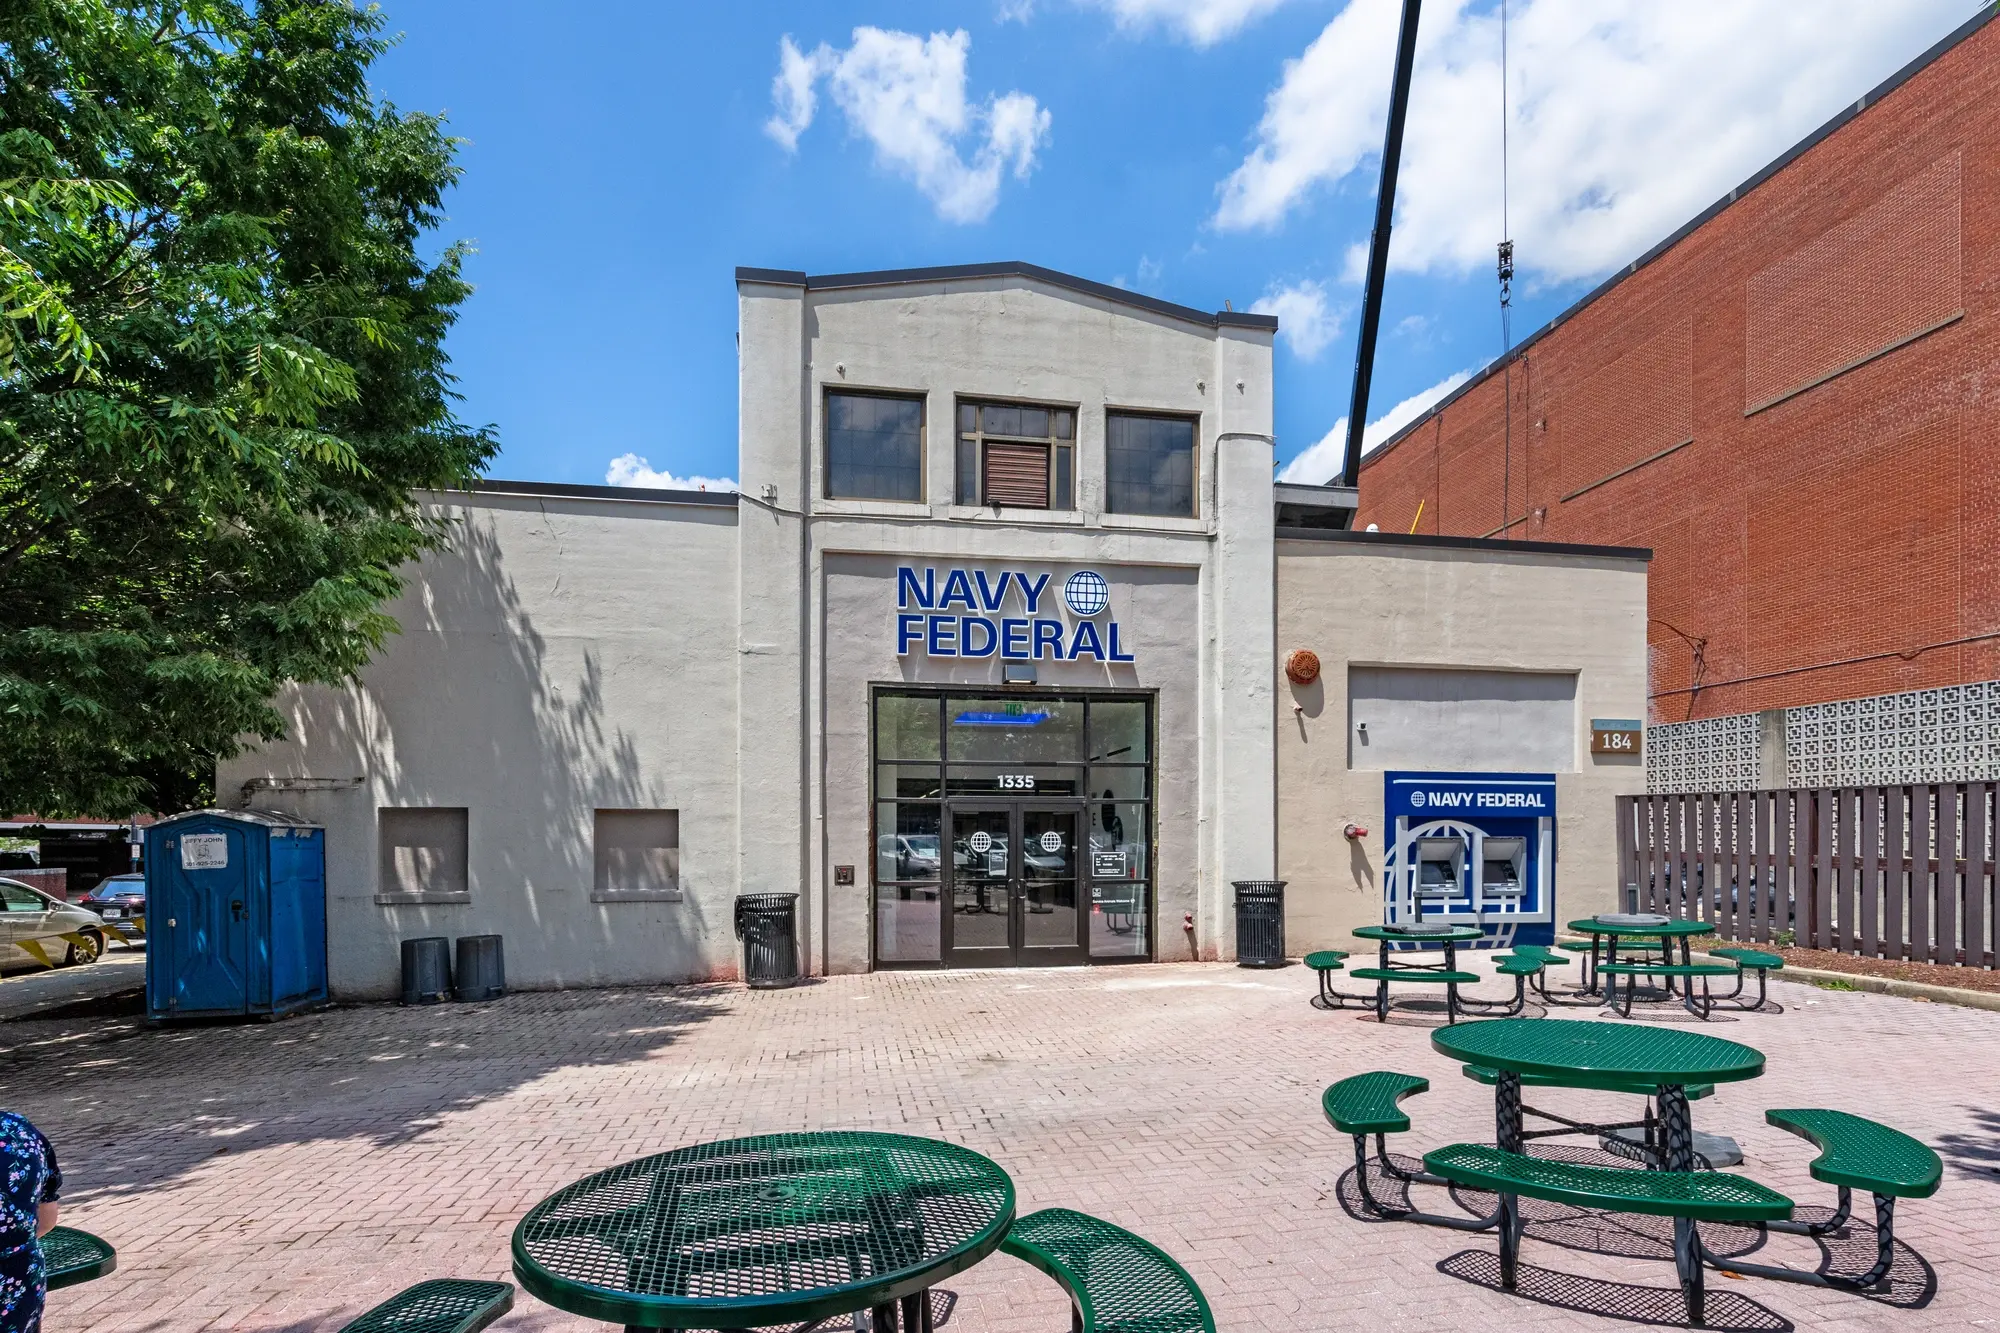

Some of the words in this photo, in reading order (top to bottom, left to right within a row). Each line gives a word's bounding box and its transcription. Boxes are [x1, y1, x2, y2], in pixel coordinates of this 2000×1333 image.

[897, 566, 1052, 615] NAVY
[897, 613, 1135, 663] FEDERAL
[1602, 733, 1632, 749] 184
[997, 775, 1035, 788] 1335
[1428, 792, 1474, 807] NAVY
[1476, 793, 1546, 807] FEDERAL
